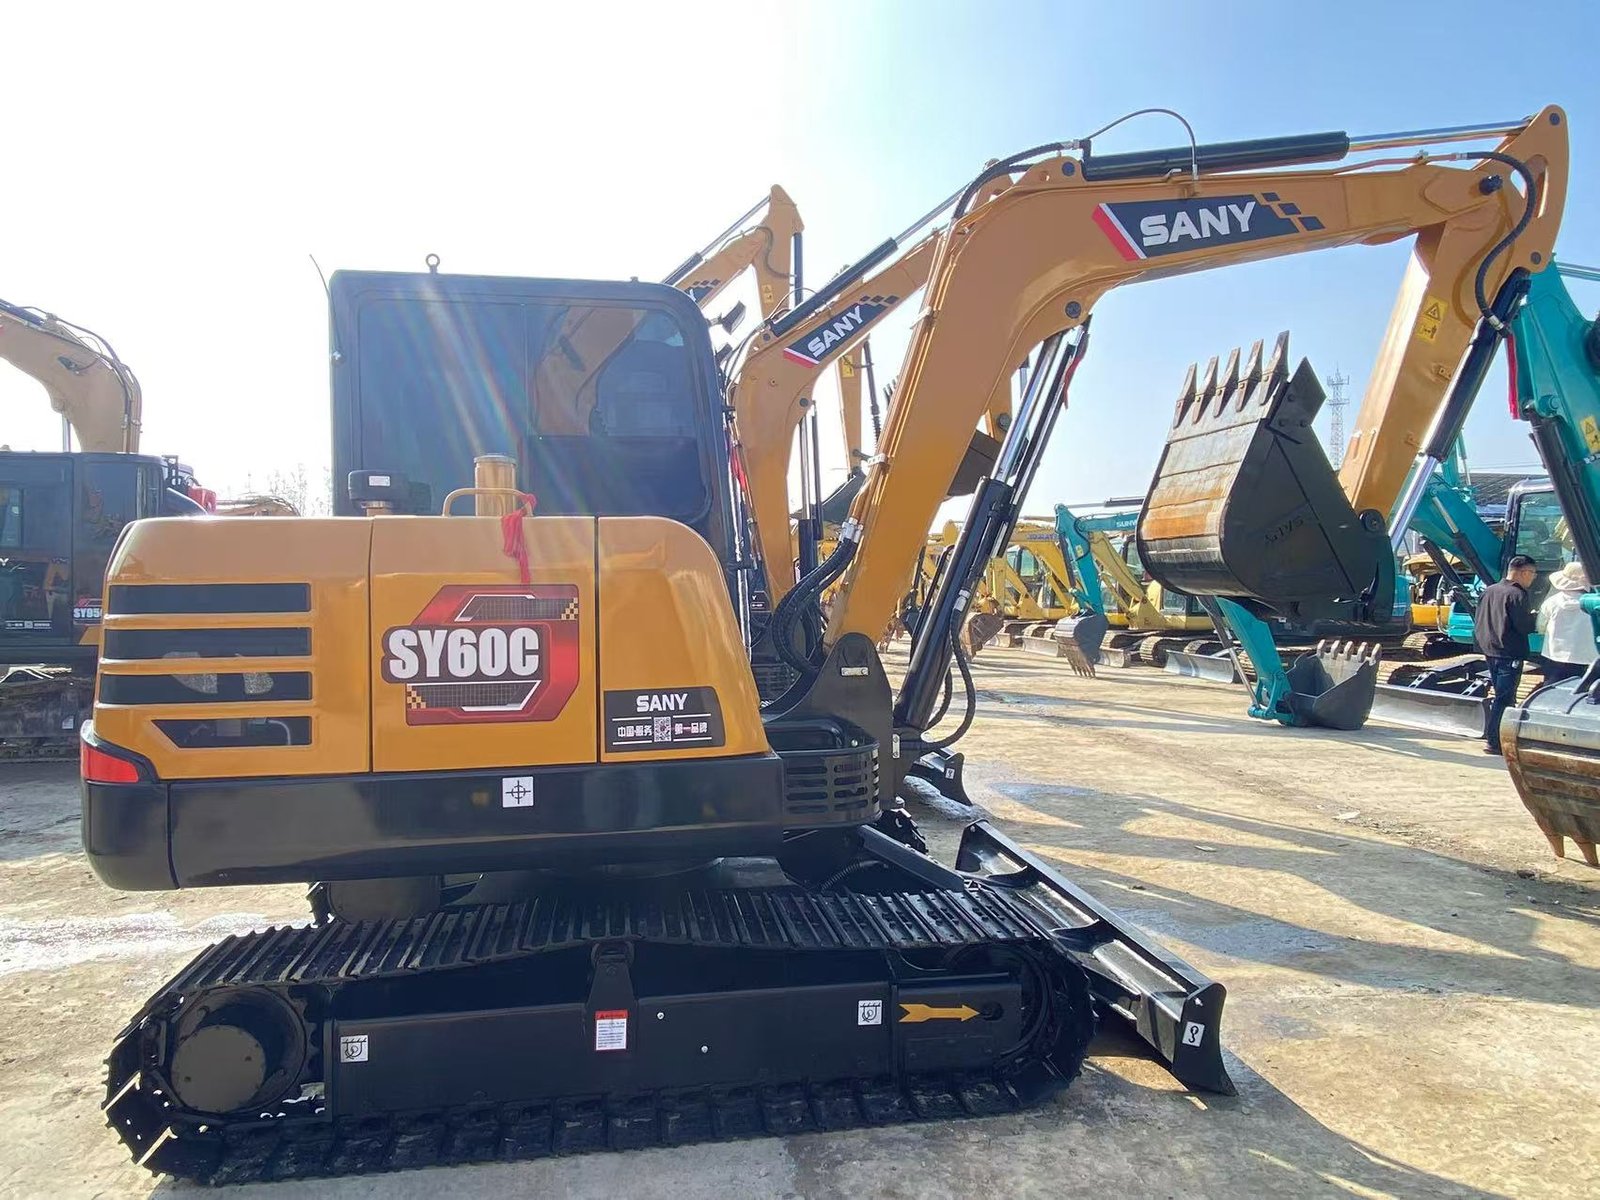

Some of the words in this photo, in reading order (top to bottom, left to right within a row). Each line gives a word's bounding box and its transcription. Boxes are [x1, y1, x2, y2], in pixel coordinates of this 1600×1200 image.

[1140, 201, 1256, 247] SANY
[807, 305, 863, 357] SANY
[1117, 518, 1138, 528] SUNW
[388, 627, 539, 680] SY60C
[636, 693, 688, 713] SANY
